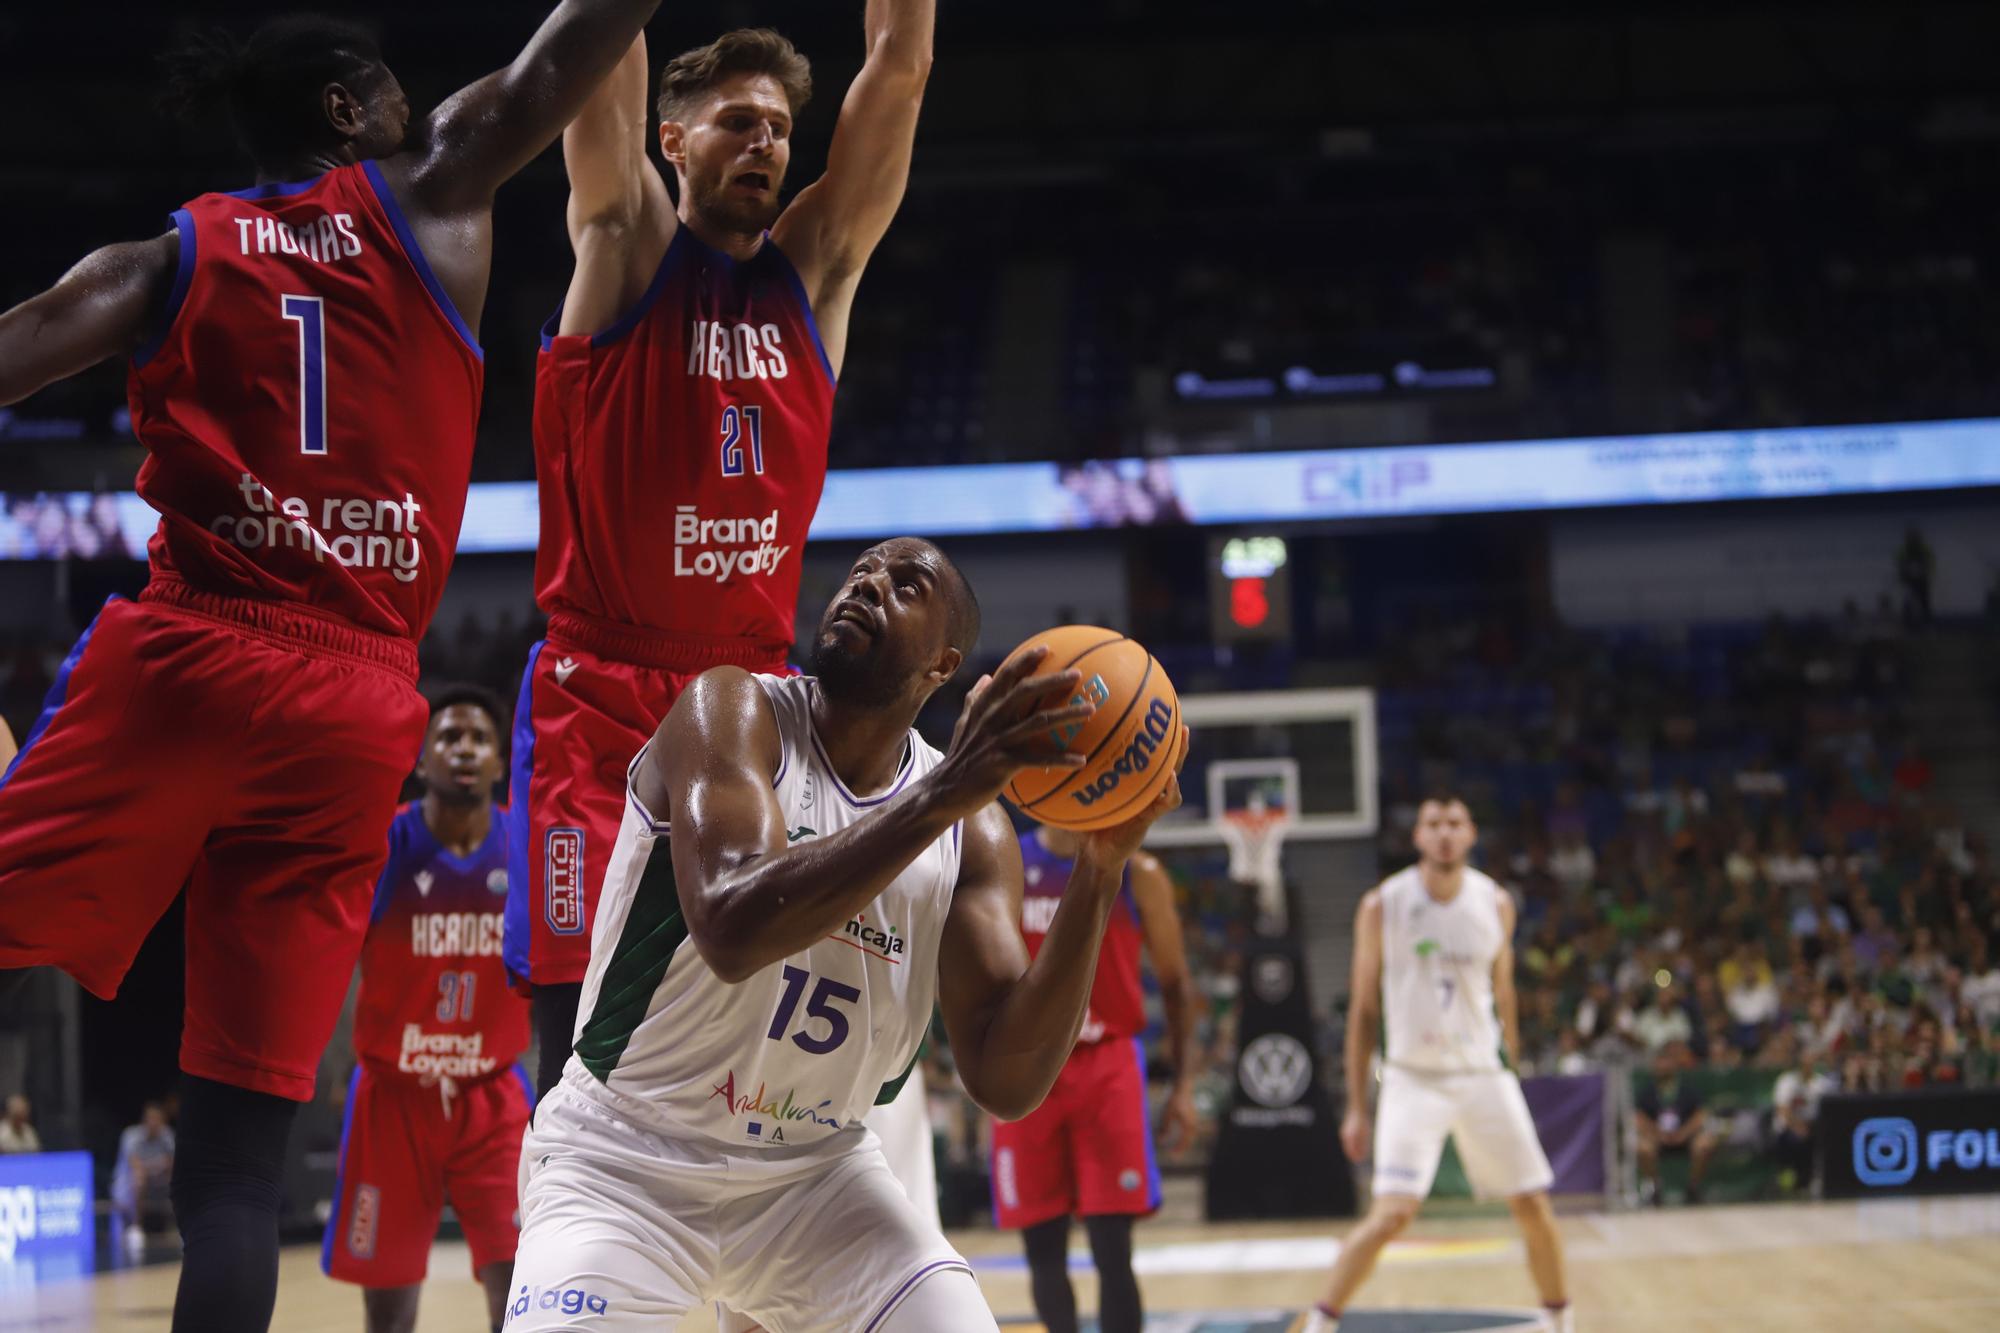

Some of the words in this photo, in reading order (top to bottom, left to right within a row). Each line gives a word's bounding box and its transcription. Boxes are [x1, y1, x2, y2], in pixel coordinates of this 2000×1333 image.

[233, 213, 362, 263] THOMAS
[281, 293, 328, 455] 1
[687, 319, 788, 381] HEROES
[720, 405, 764, 477] 21
[321, 492, 421, 533] rent
[674, 505, 778, 545] Brand
[210, 513, 420, 582] company
[674, 542, 791, 583] Loyalty
[552, 839, 568, 923] OTTO
[567, 839, 577, 922] workforce.eu
[436, 970, 477, 1024] 31
[767, 964, 861, 1055] 15
[402, 1022, 483, 1056] Brand
